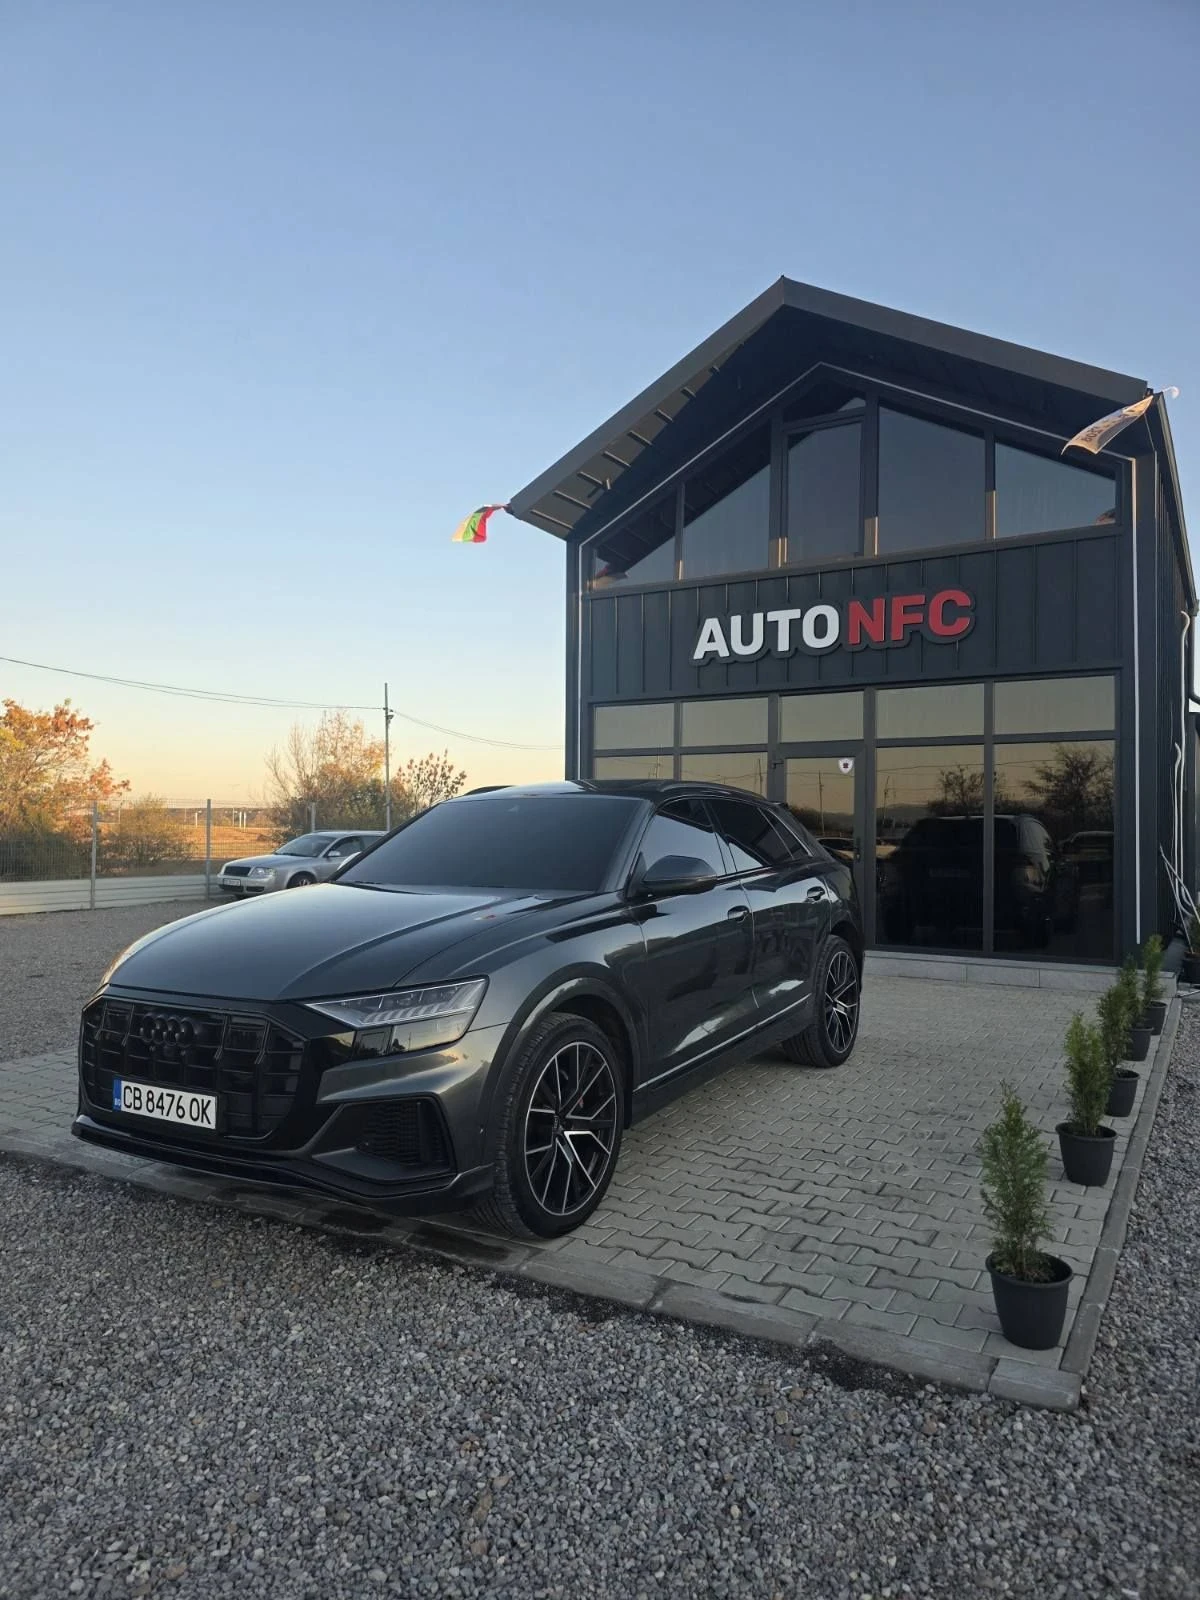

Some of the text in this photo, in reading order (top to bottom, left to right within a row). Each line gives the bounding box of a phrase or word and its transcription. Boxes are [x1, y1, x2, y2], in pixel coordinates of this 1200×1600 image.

[693, 589, 971, 660] AUTO NFC
[123, 1085, 211, 1125] CB 8476 OK
